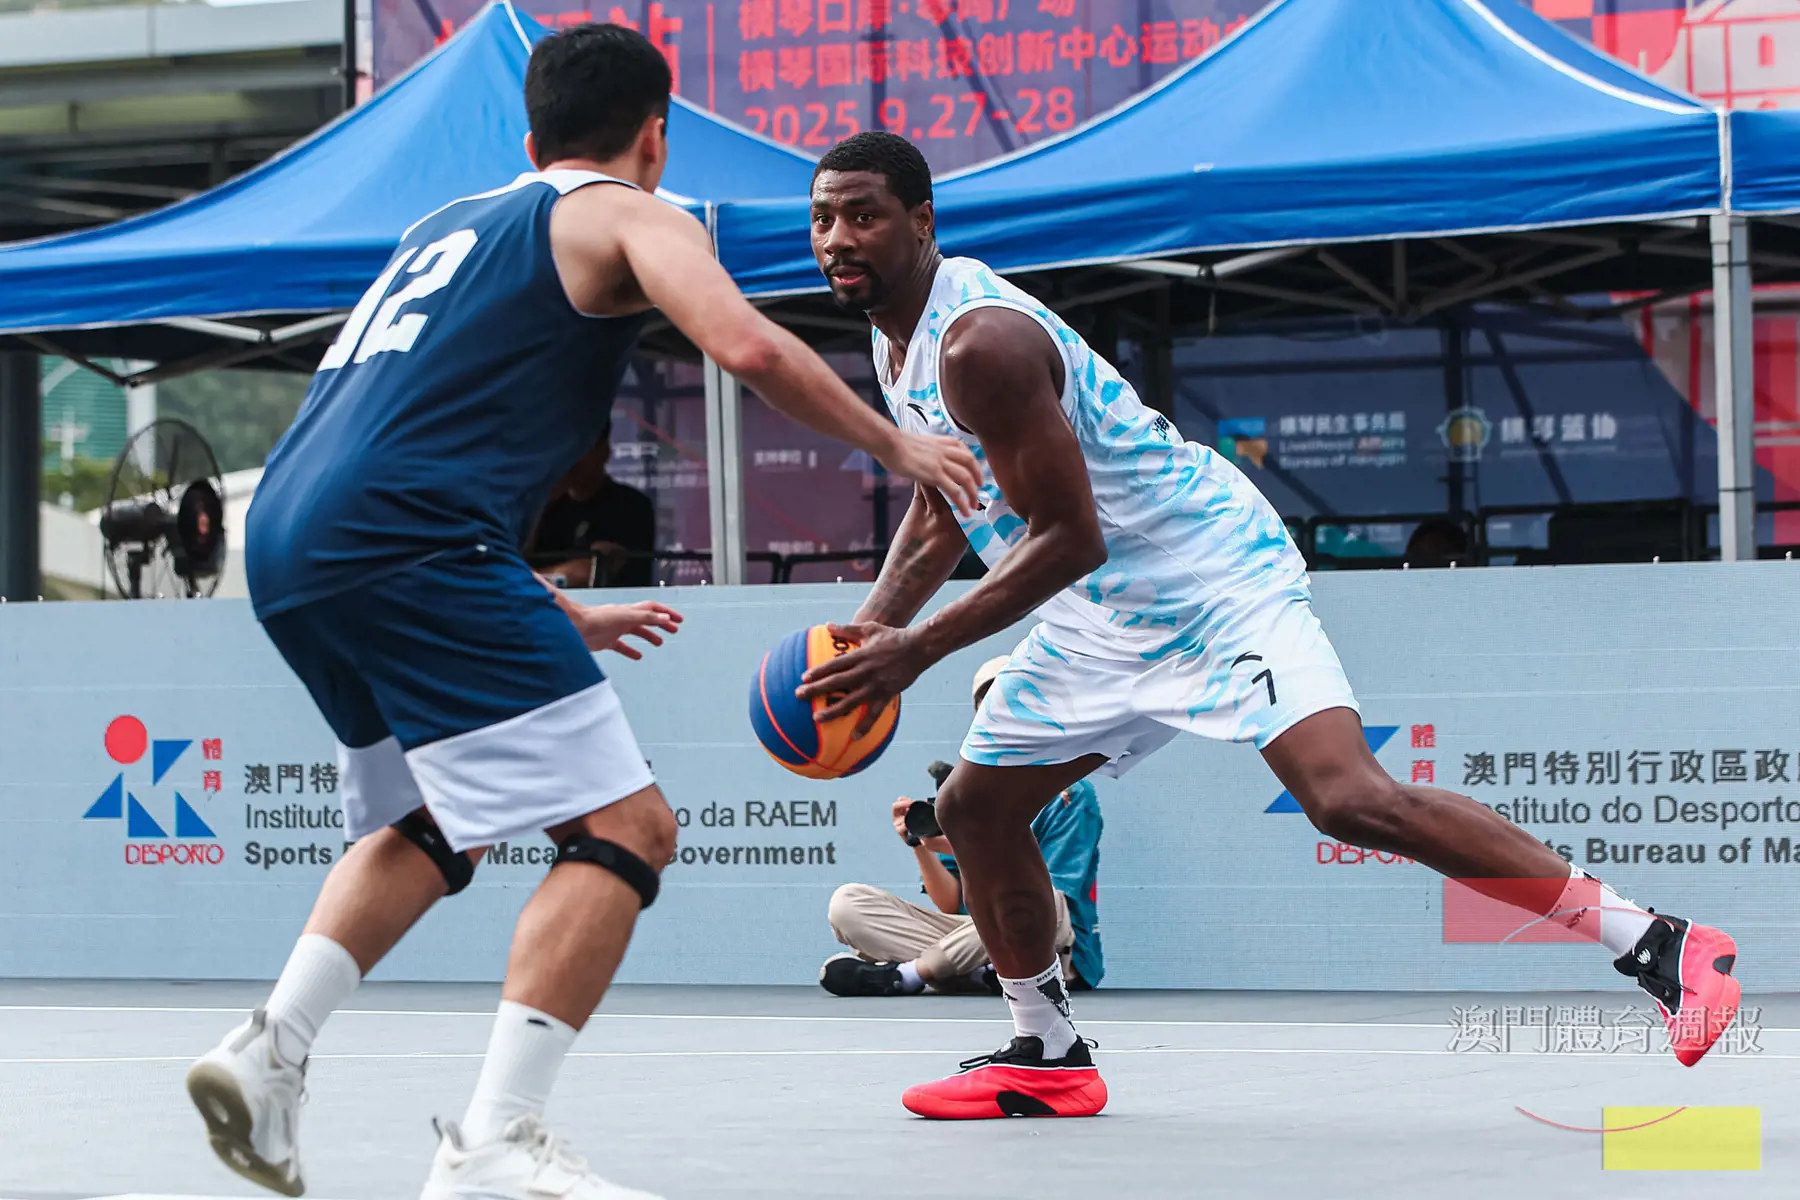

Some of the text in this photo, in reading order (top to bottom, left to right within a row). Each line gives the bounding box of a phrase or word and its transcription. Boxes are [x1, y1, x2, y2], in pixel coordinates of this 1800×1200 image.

[317, 228, 479, 364] 12
[1251, 668, 1277, 706] 7
[1463, 749, 1800, 785] 澳門特別行政區政
[700, 801, 735, 828] da
[745, 800, 837, 828] RAEM
[1601, 796, 1641, 824] do
[244, 841, 332, 870] Sports
[486, 841, 557, 865] Maca
[1586, 838, 1706, 864] Bureau
[1719, 837, 1752, 864] of
